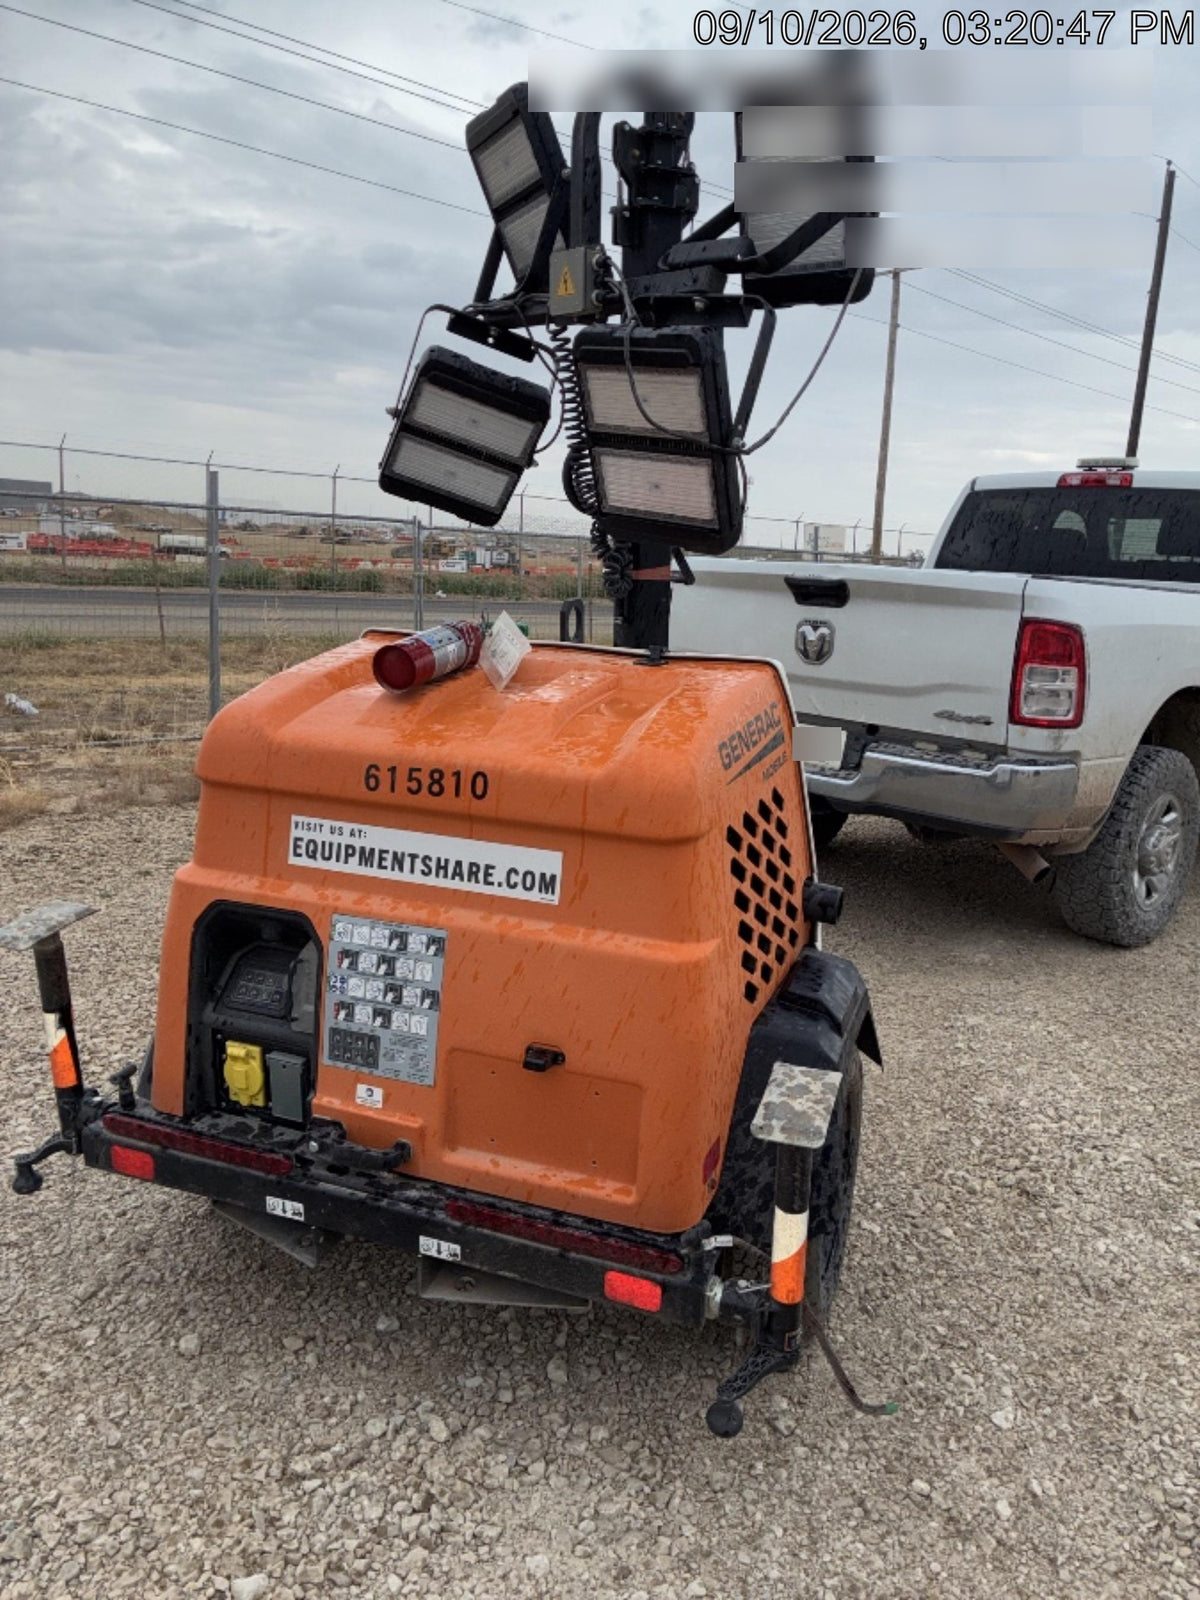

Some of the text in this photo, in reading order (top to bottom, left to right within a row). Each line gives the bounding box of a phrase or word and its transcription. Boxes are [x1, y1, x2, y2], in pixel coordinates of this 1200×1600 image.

[717, 702, 782, 771] GENERAC
[364, 763, 490, 801] 615810
[294, 820, 368, 839] VISIT US AT:
[291, 836, 559, 896] EQUIPMENTSHARE.COM
